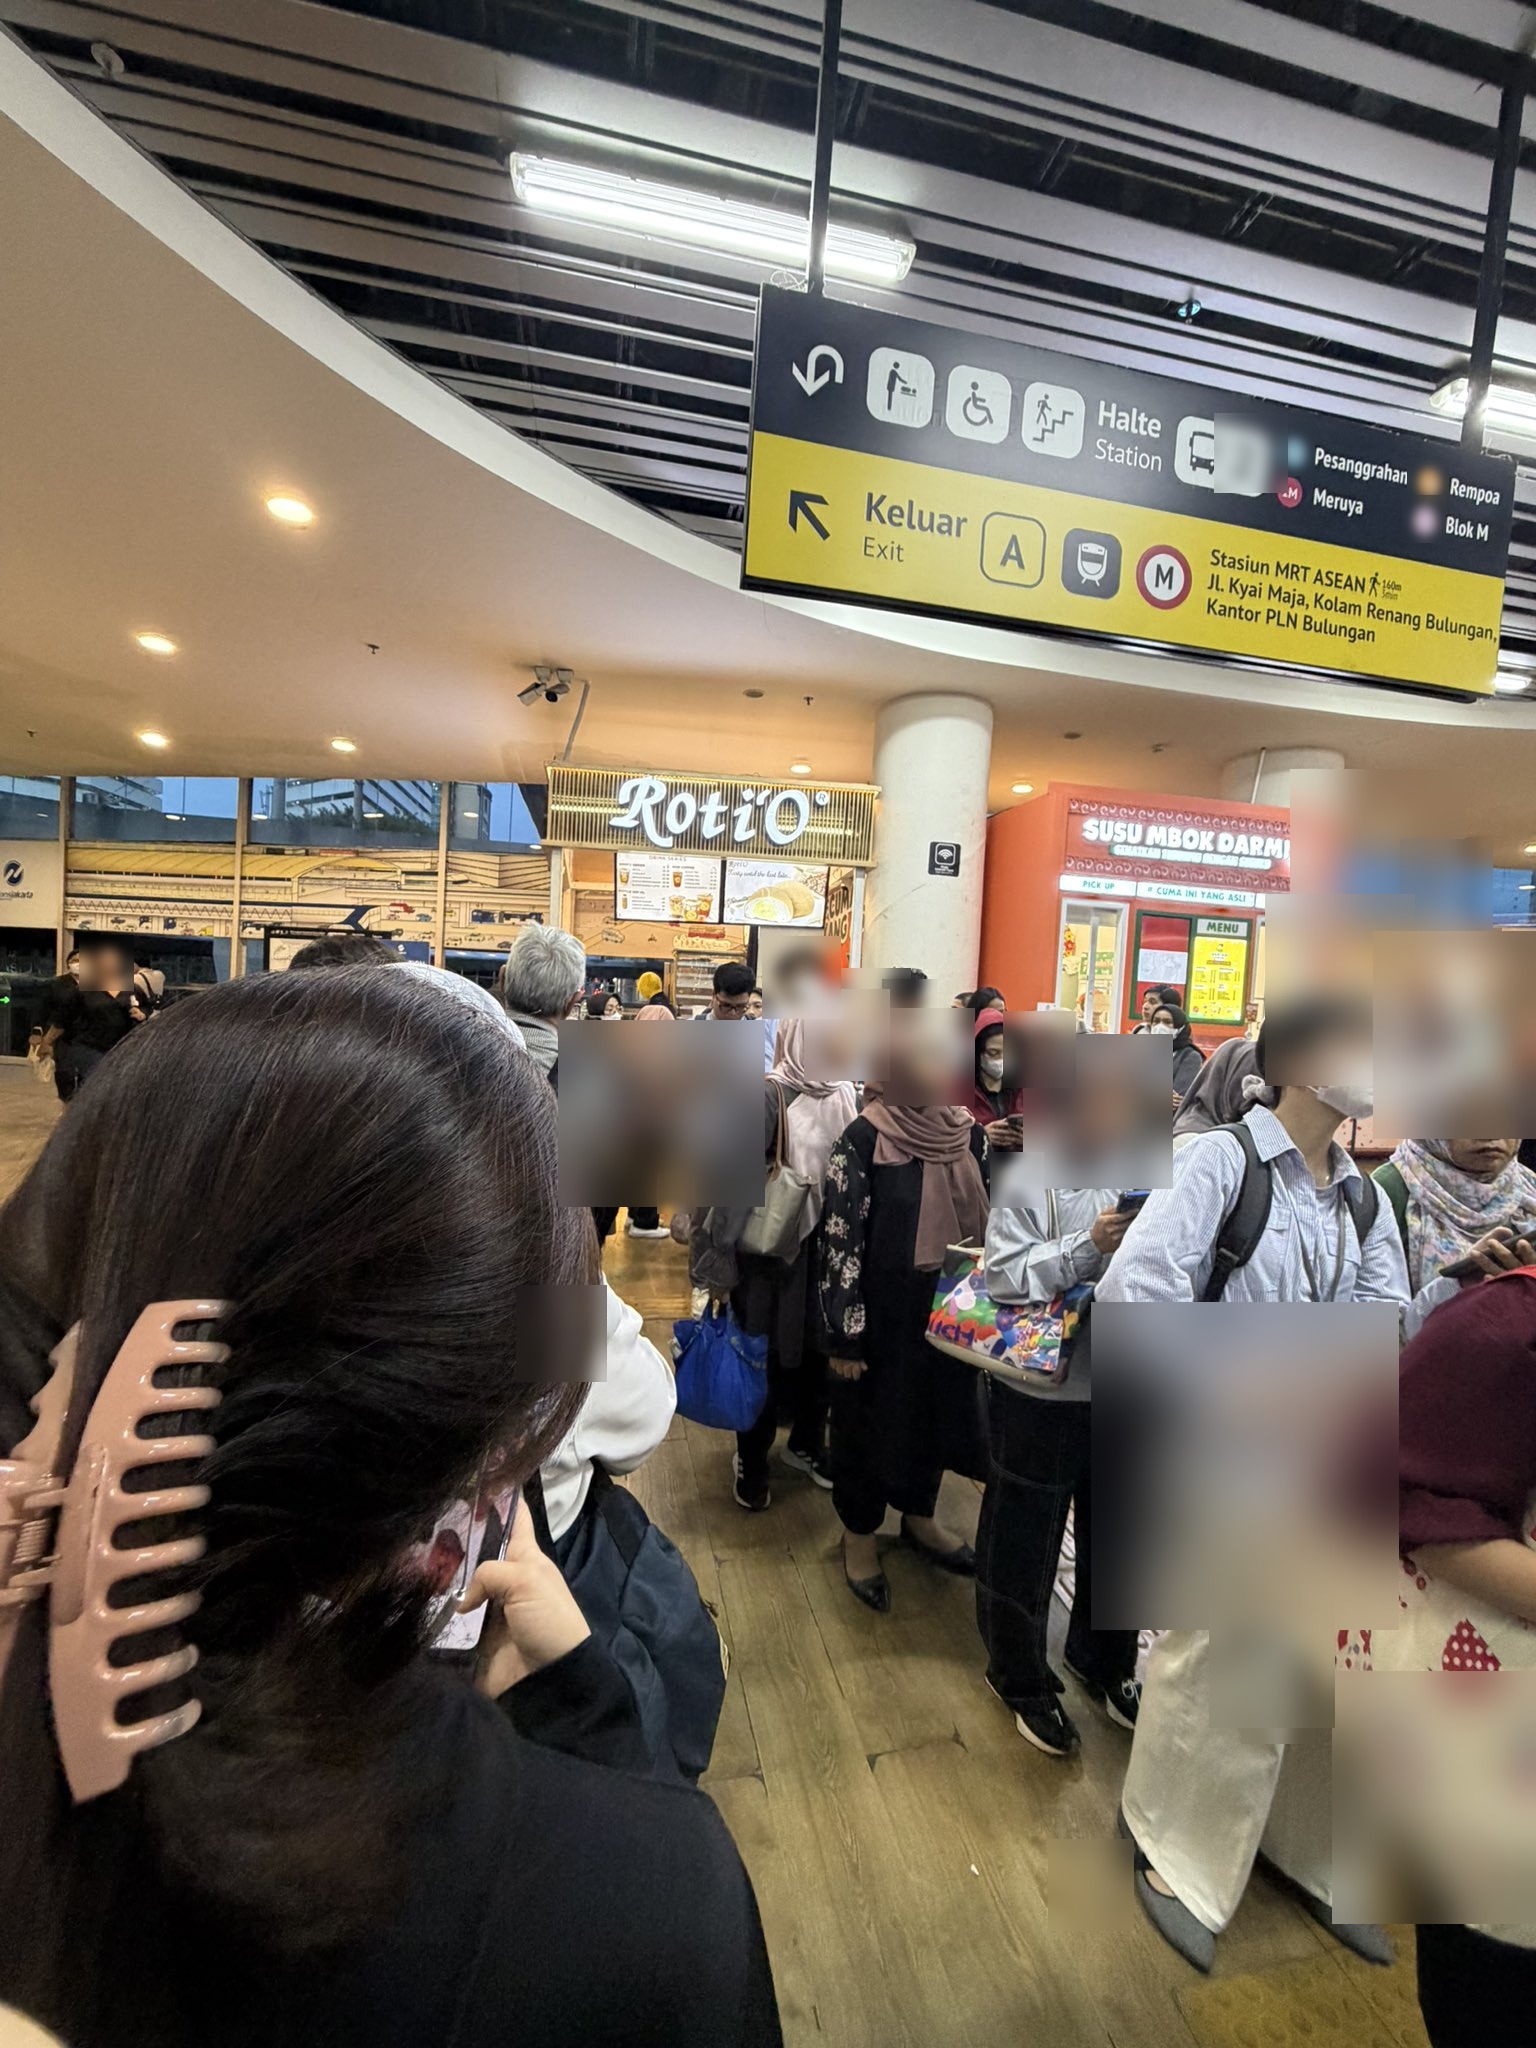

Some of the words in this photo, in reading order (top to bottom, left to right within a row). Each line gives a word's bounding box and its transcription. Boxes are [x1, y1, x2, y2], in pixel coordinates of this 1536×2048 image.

[1098, 400, 1162, 438] Halte
[1095, 438, 1162, 472] Station
[1314, 446, 1408, 486] Pesanggrahan
[1312, 487, 1364, 517] Meruya
[1450, 477, 1501, 506] Rempoa
[865, 492, 968, 538] Keluar
[1445, 516, 1473, 539] Blok
[1476, 523, 1490, 542] M
[863, 536, 905, 563] Exit
[1000, 534, 1026, 571] A
[1154, 563, 1175, 591] M
[1210, 548, 1270, 576] Stasiun
[1275, 560, 1311, 583] MRT
[1313, 568, 1366, 594] ASEAN
[1206, 597, 1261, 623] Kantor
[1266, 608, 1298, 630] PLN
[1302, 614, 1376, 644] Bulungan
[1207, 573, 1224, 593] Jl.
[1229, 577, 1263, 600] Kyai
[1268, 584, 1309, 610] Maja,
[1313, 592, 1362, 617] Kolam
[1366, 602, 1421, 631] Renang
[1425, 613, 1498, 643] Bulungan,
[1082, 818, 1143, 844] SUSU
[1145, 825, 1216, 852] MBOK
[1082, 880, 1104, 889] PICK
[1104, 882, 1115, 890] UP
[1156, 887, 1182, 897] CUMA
[1185, 889, 1197, 898] INI
[1200, 891, 1225, 901] YANG
[1227, 894, 1246, 902] ASLI
[1206, 921, 1239, 934] MENU
